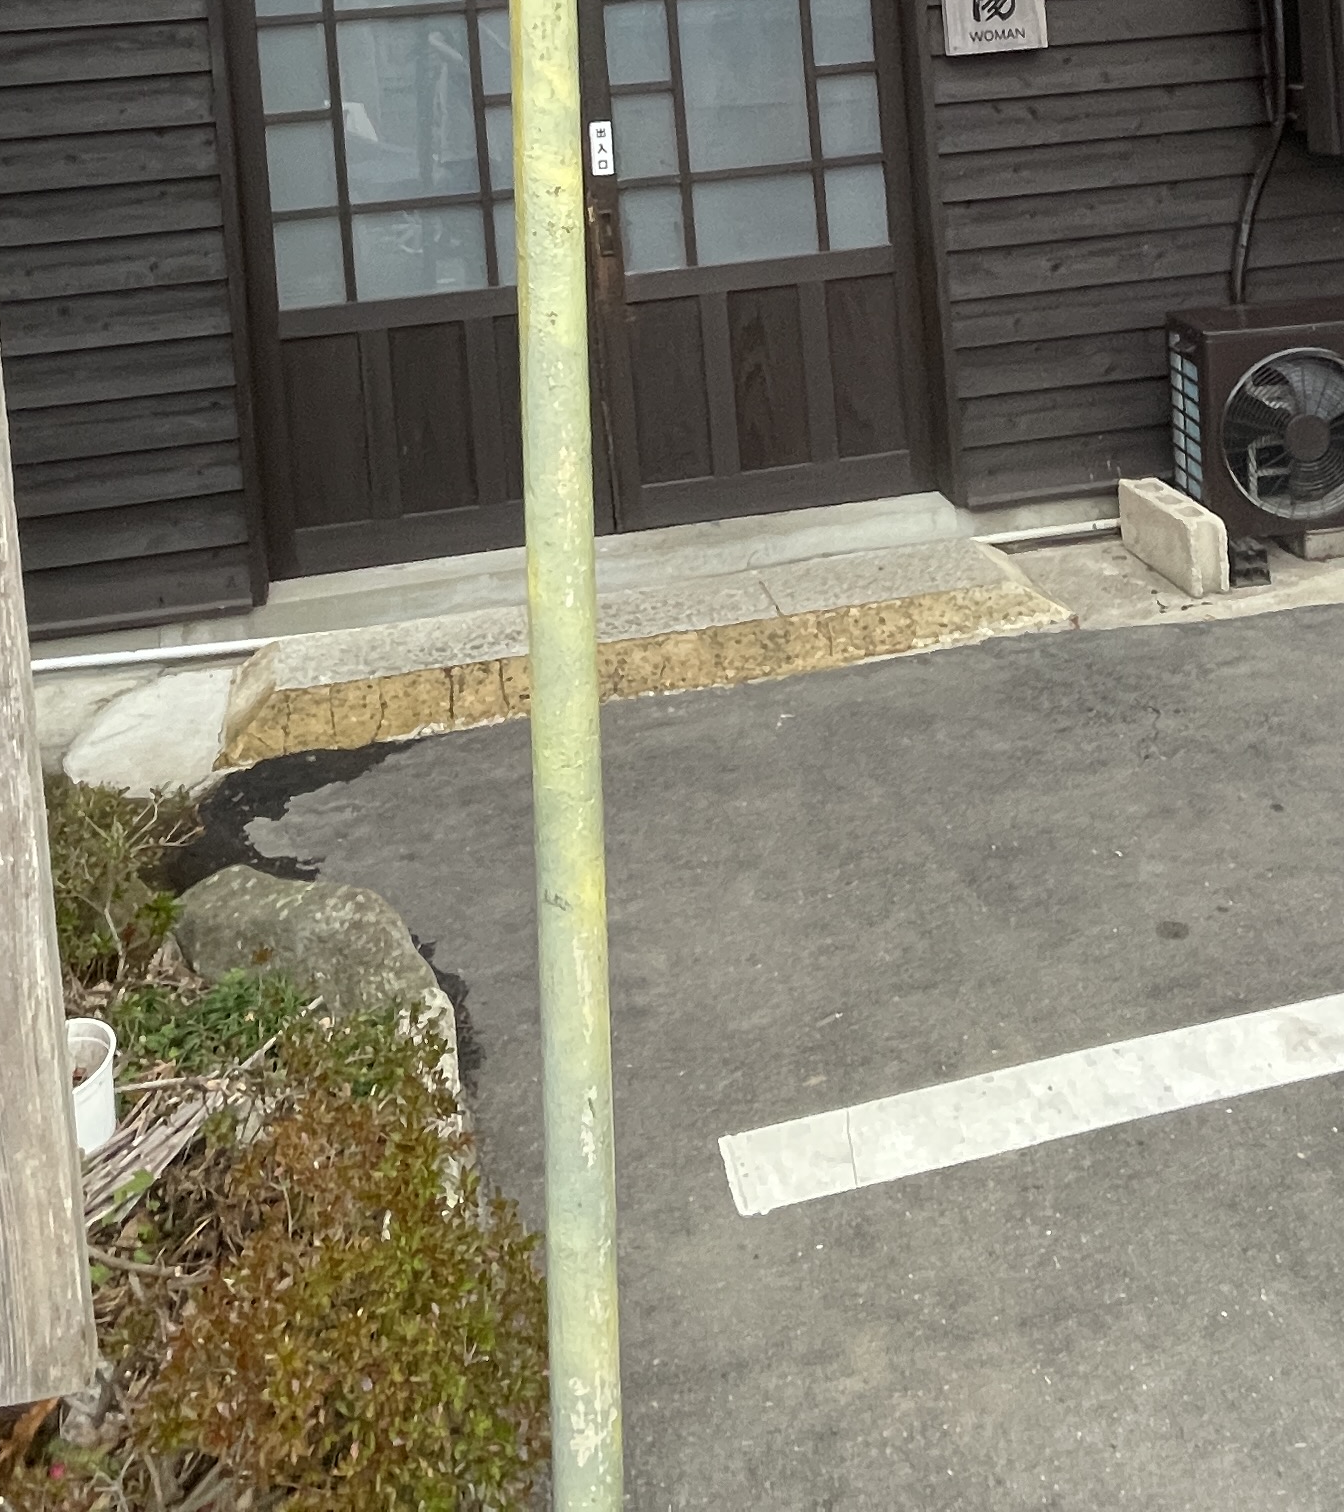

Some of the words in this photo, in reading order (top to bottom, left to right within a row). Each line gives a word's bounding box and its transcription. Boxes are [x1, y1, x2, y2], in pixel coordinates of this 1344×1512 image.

[969, 27, 1026, 43] WOMAN
[595, 127, 609, 170] 出入口
